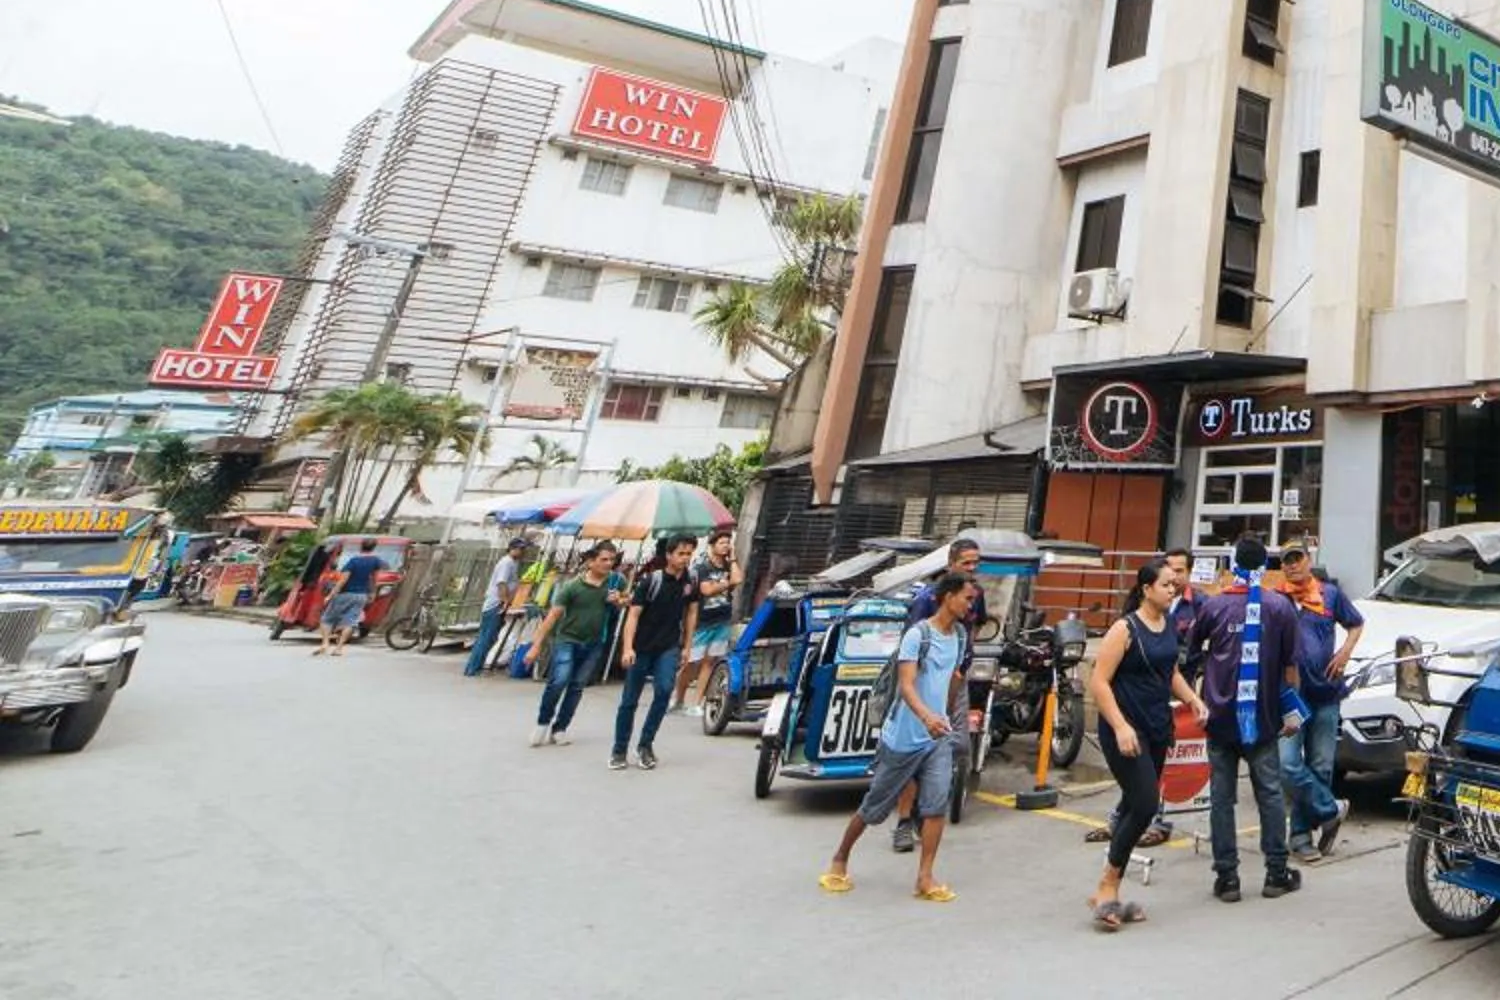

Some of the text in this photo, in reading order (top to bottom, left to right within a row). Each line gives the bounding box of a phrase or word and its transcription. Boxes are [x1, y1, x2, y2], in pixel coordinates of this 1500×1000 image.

[624, 83, 698, 120] WIN
[589, 107, 708, 152] HOTEL
[211, 279, 278, 349] WIN
[160, 355, 269, 381] HOTEL
[1104, 395, 1137, 435] T
[1230, 398, 1312, 437] Turks
